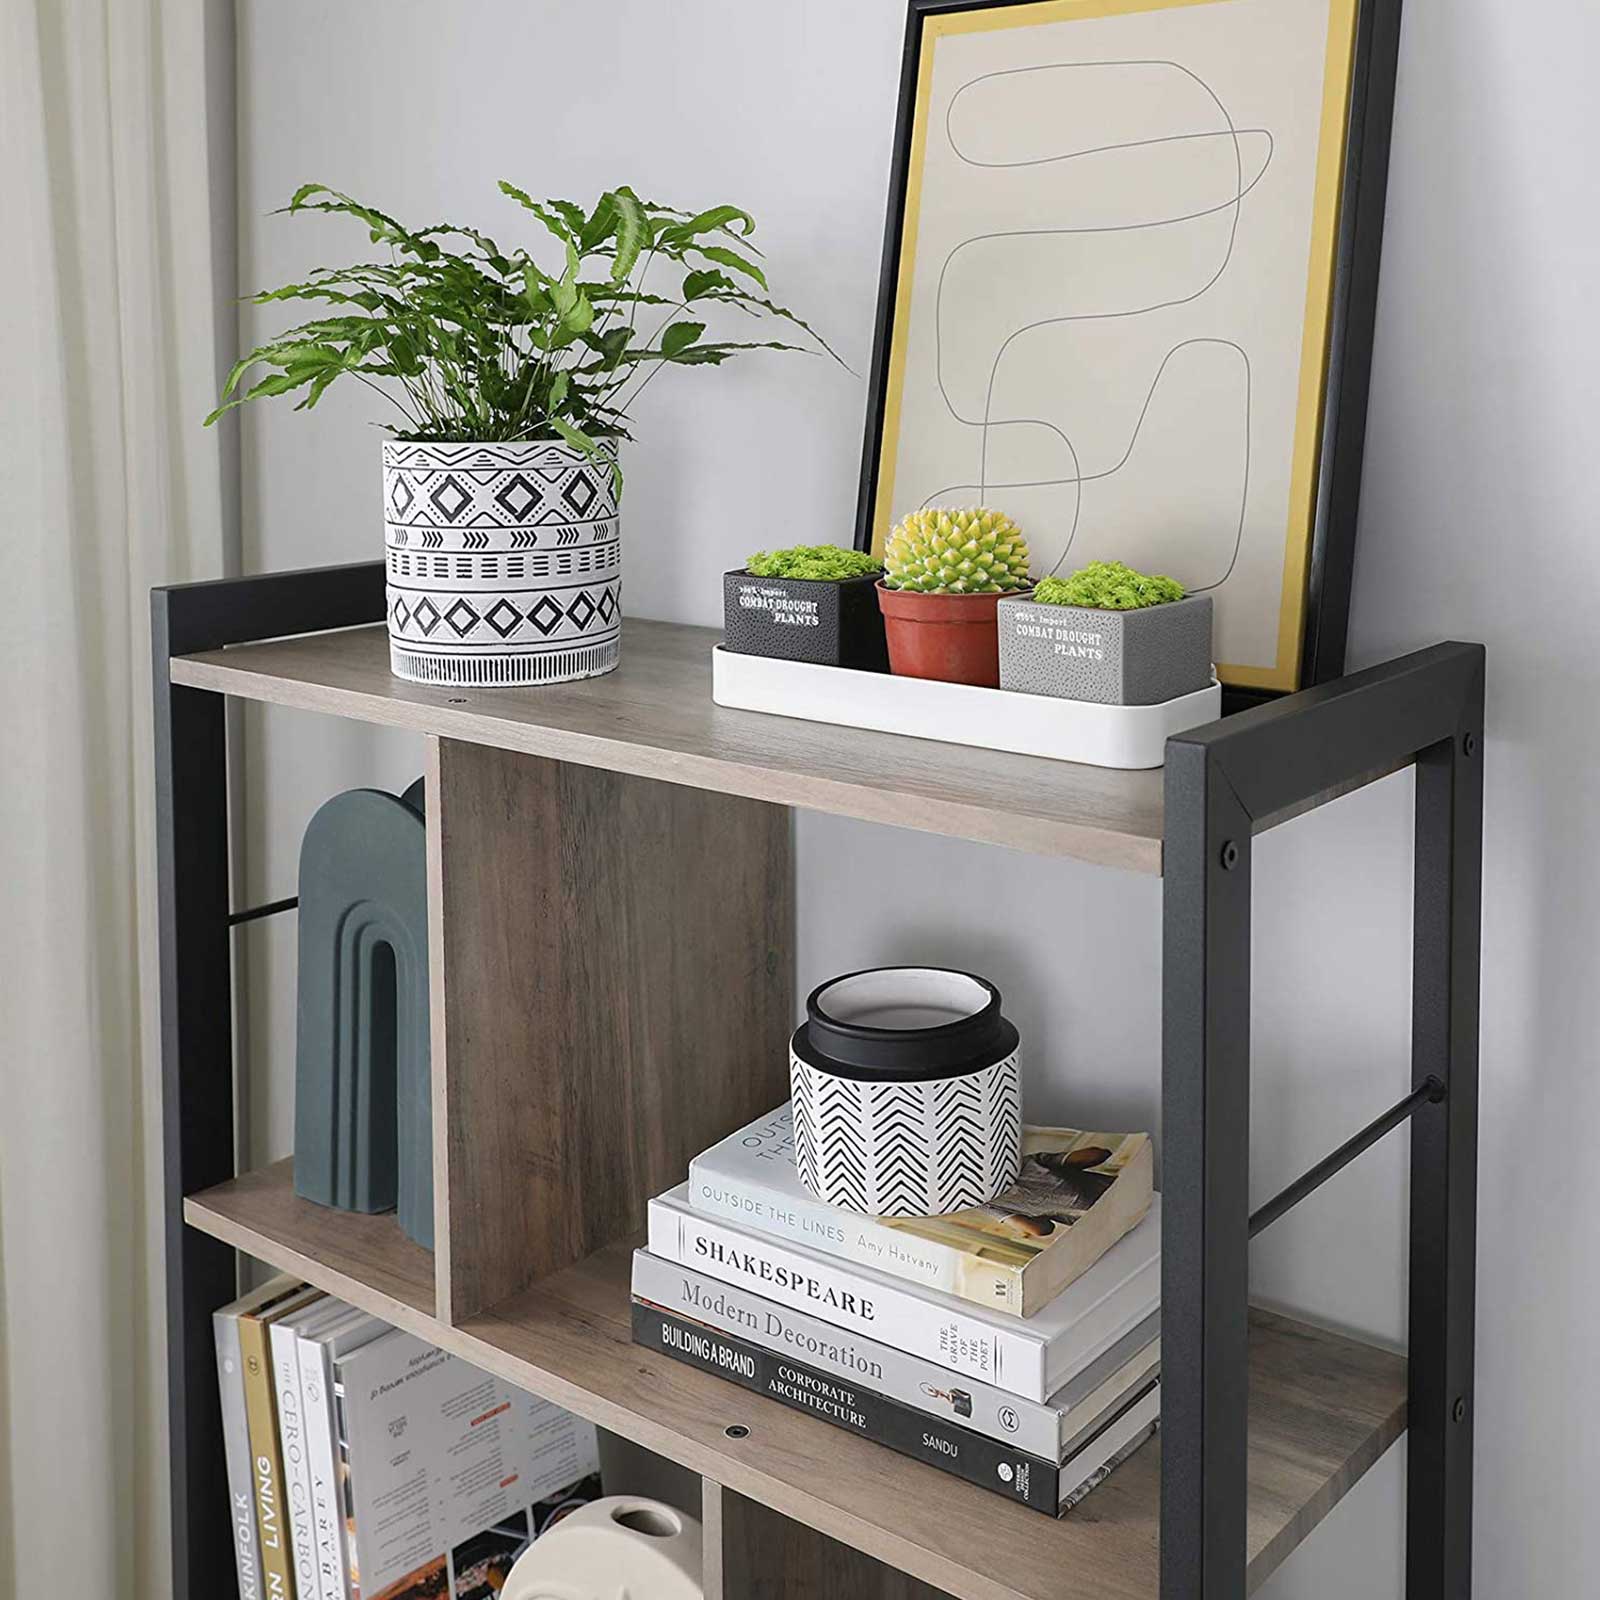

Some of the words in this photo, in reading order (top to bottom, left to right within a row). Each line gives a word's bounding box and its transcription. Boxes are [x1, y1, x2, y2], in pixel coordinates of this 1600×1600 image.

[739, 595, 774, 609] COMBAT
[776, 599, 818, 614] DROUGHT
[774, 612, 819, 626] PLANTS
[1016, 624, 1053, 639] COMBAT
[1055, 628, 1102, 646] DROUGHT
[1054, 643, 1103, 660] PLANTS
[702, 1186, 763, 1216] OUTSIDE
[769, 1207, 796, 1226] THE
[802, 1218, 845, 1243] LINES
[857, 1234, 883, 1256] Amy
[889, 1245, 940, 1275] Hatvany
[694, 1236, 876, 1321] SHAKESPEARE
[681, 1280, 759, 1330] Modern
[764, 1311, 884, 1380] Decoration
[940, 1327, 948, 1351] THE
[950, 1323, 958, 1364] GRAVE
[960, 1338, 968, 1355] OF
[970, 1339, 978, 1362] THE
[980, 1338, 989, 1371] POET
[778, 1365, 856, 1407] CORPORATE
[768, 1379, 867, 1429] ARCHITECTURE
[922, 1433, 958, 1458] SANDU
[257, 1456, 279, 1548] LIVING
[234, 1493, 256, 1600] KINFOLK
